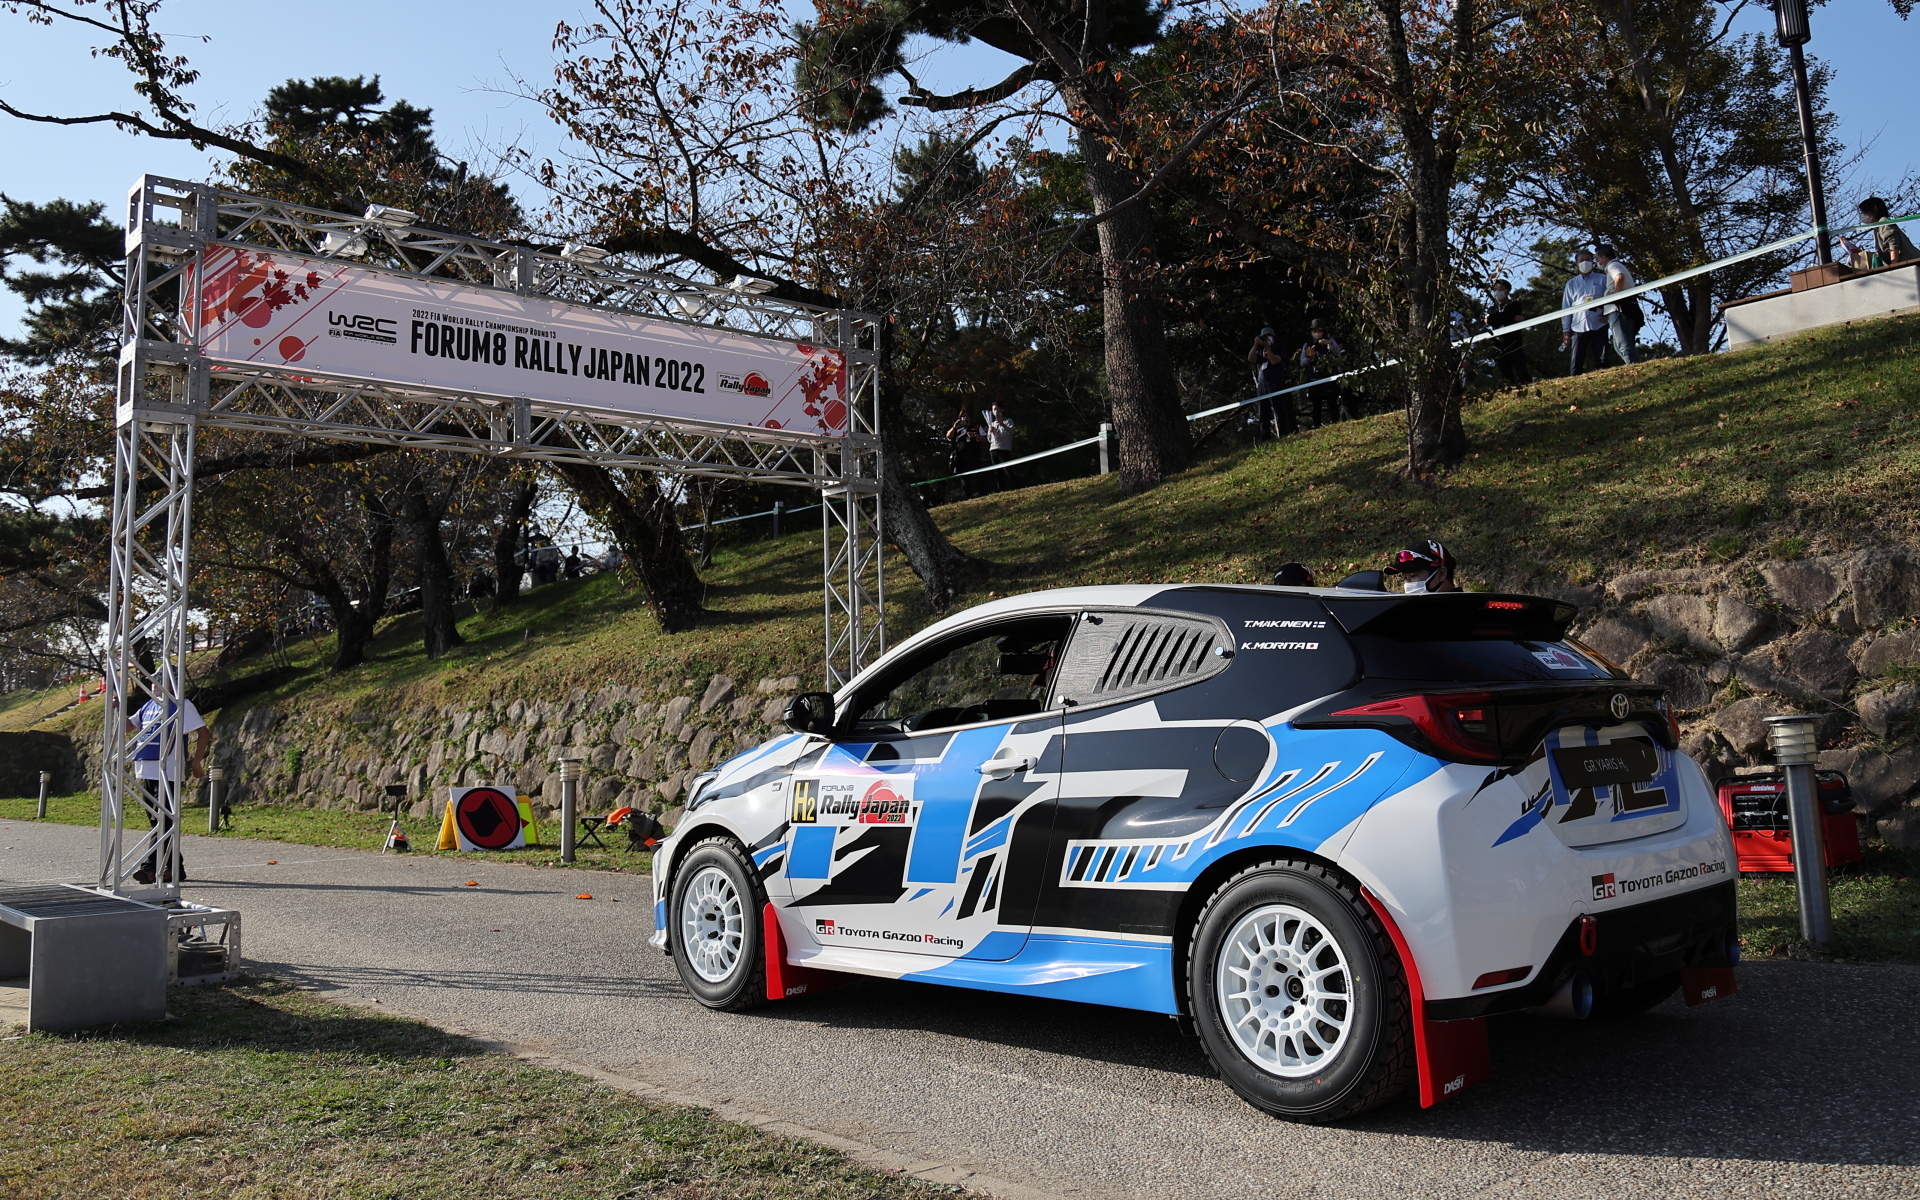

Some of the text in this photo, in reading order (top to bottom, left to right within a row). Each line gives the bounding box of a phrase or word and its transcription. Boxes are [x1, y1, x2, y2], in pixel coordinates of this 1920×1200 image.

[329, 310, 397, 335] WRC
[412, 309, 429, 320] 2022
[430, 311, 441, 321] FIA
[549, 330, 557, 339] 13
[411, 319, 705, 394] FORUM8 RALLY JAPAN 2022
[720, 379, 771, 395] Rally Japan
[1241, 641, 1305, 650] K.MORITA
[1583, 760, 1598, 773] GR
[1595, 757, 1619, 771] YARIS
[793, 782, 816, 822] H2
[820, 794, 910, 820] Rally Japan
[886, 814, 902, 822] 2022
[1593, 860, 1726, 899] GR TOYOTA GAZOO Racing
[816, 924, 964, 949] GR TOYOTA GAZOO Racing
[786, 985, 807, 996] DASH
[1701, 988, 1717, 999] DASH
[1444, 1076, 1464, 1095] DASH
